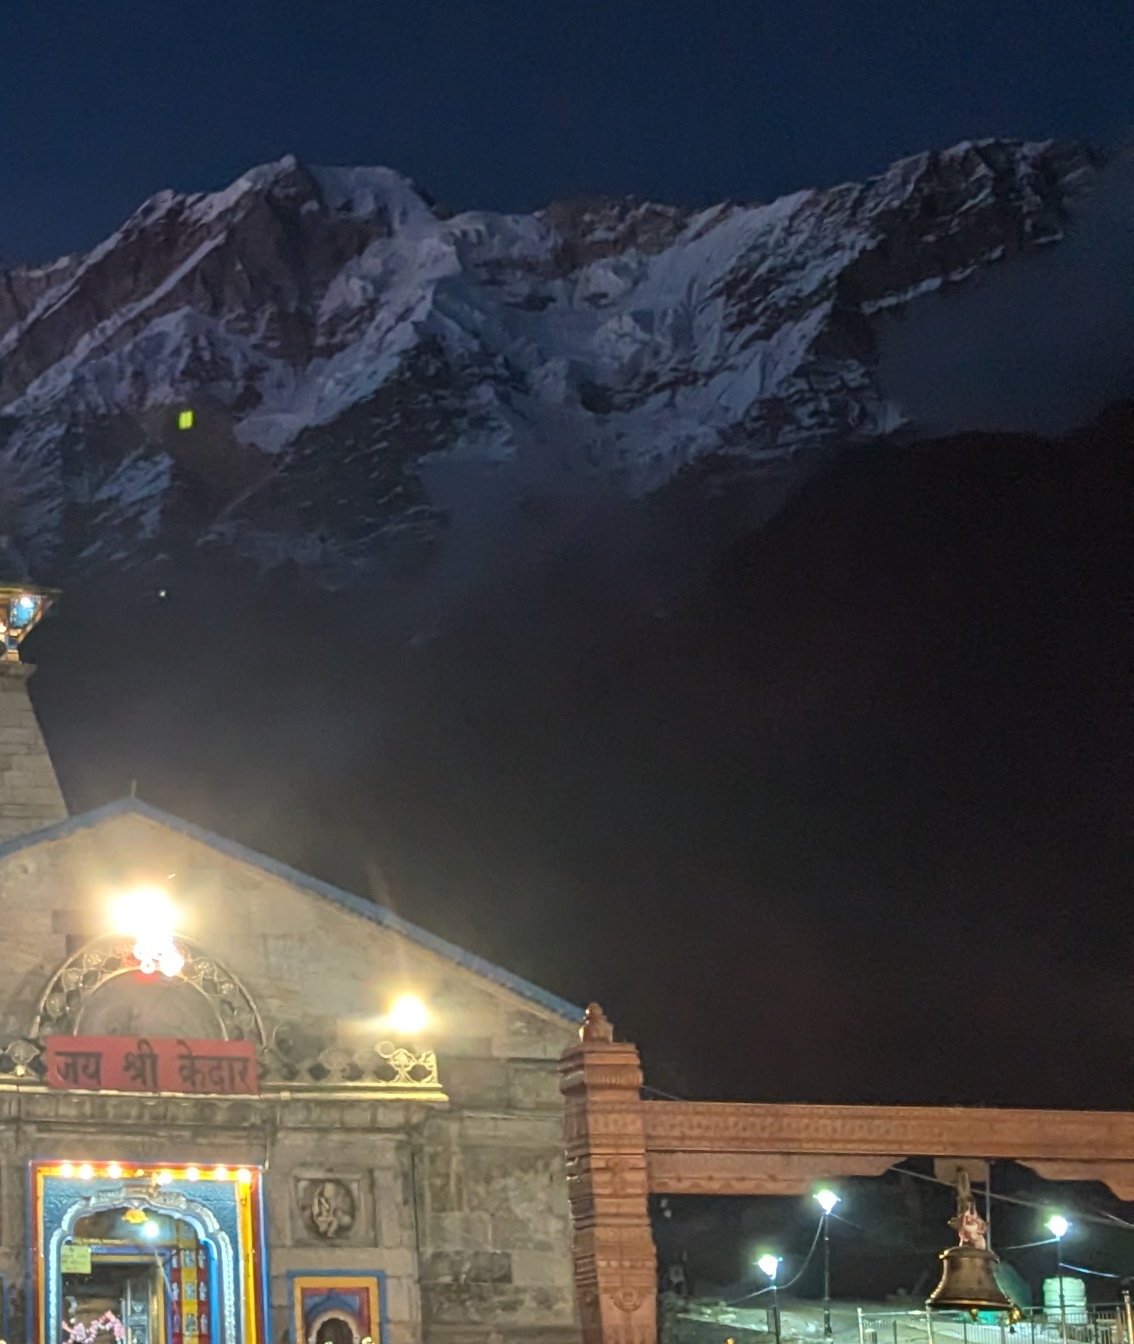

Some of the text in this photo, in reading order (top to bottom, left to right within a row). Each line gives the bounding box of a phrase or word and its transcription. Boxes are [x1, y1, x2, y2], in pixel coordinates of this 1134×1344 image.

[54, 1038, 250, 1092] जय श्री केदार
